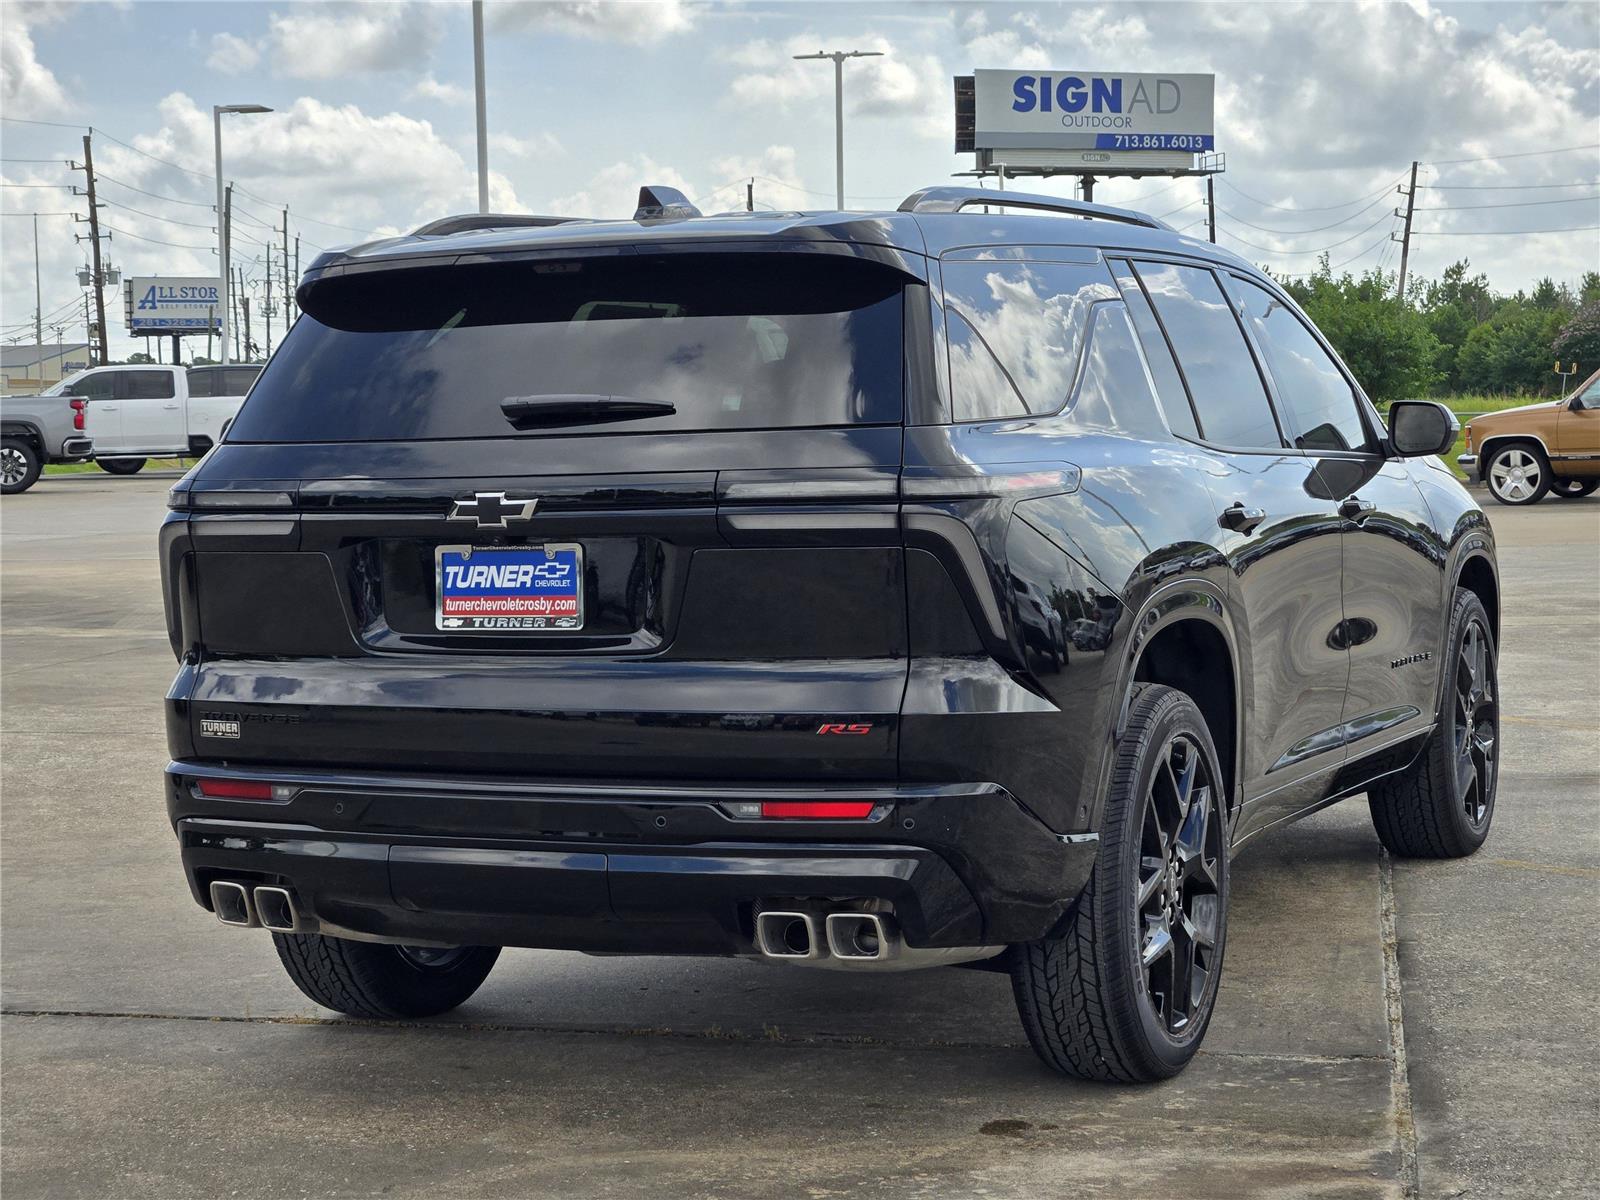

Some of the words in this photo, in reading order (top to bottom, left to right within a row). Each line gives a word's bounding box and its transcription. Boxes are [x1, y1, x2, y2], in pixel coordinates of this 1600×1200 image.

[1061, 114, 1132, 129] OUTDOOR
[1114, 134, 1203, 149] 713.861.6013
[138, 285, 177, 310] ALL
[180, 286, 219, 299] STOR
[445, 564, 535, 589] TURNER
[534, 579, 571, 588] CHEVROLET
[445, 596, 576, 614] turnerchevroletcrosby.com
[472, 617, 546, 628] TURNER
[202, 721, 238, 733] TURNER
[816, 723, 873, 735] RS
